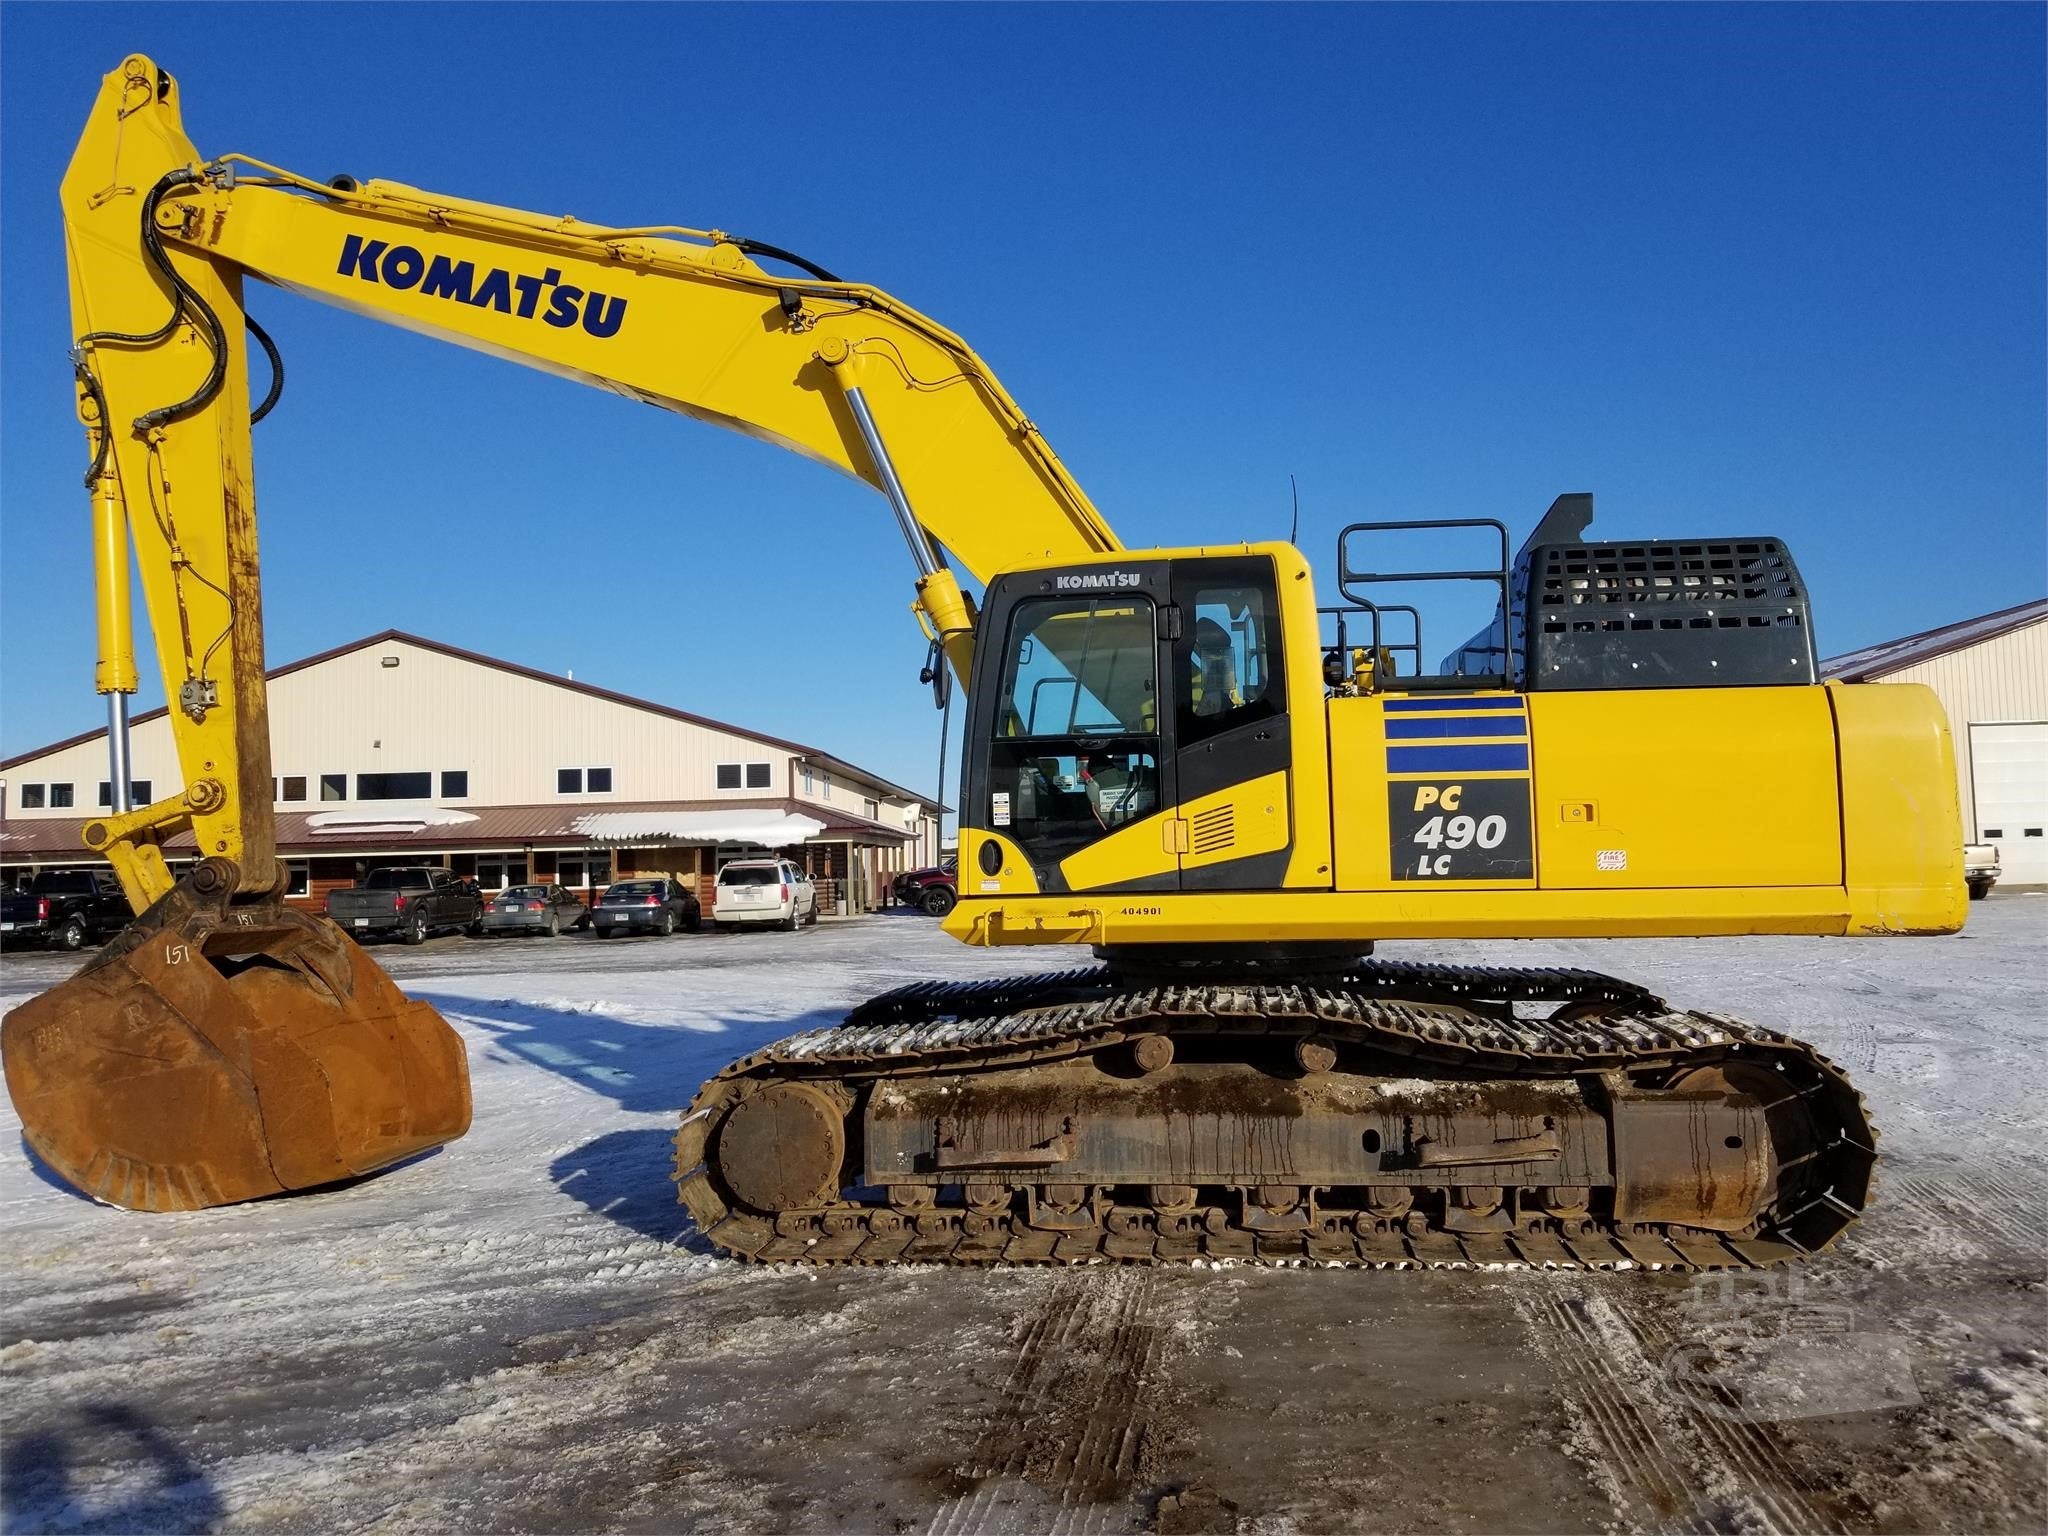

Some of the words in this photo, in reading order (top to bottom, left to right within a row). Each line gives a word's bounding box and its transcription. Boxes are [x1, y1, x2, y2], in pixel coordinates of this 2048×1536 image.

[336, 233, 629, 339] KOMATSU
[1057, 571, 1140, 589] KOMATSU
[1413, 785, 1462, 812] PC
[1413, 815, 1507, 850] 490
[1417, 855, 1451, 876] LC
[237, 914, 254, 926] 151
[1120, 907, 1161, 916] 404901
[166, 944, 190, 965] 151
